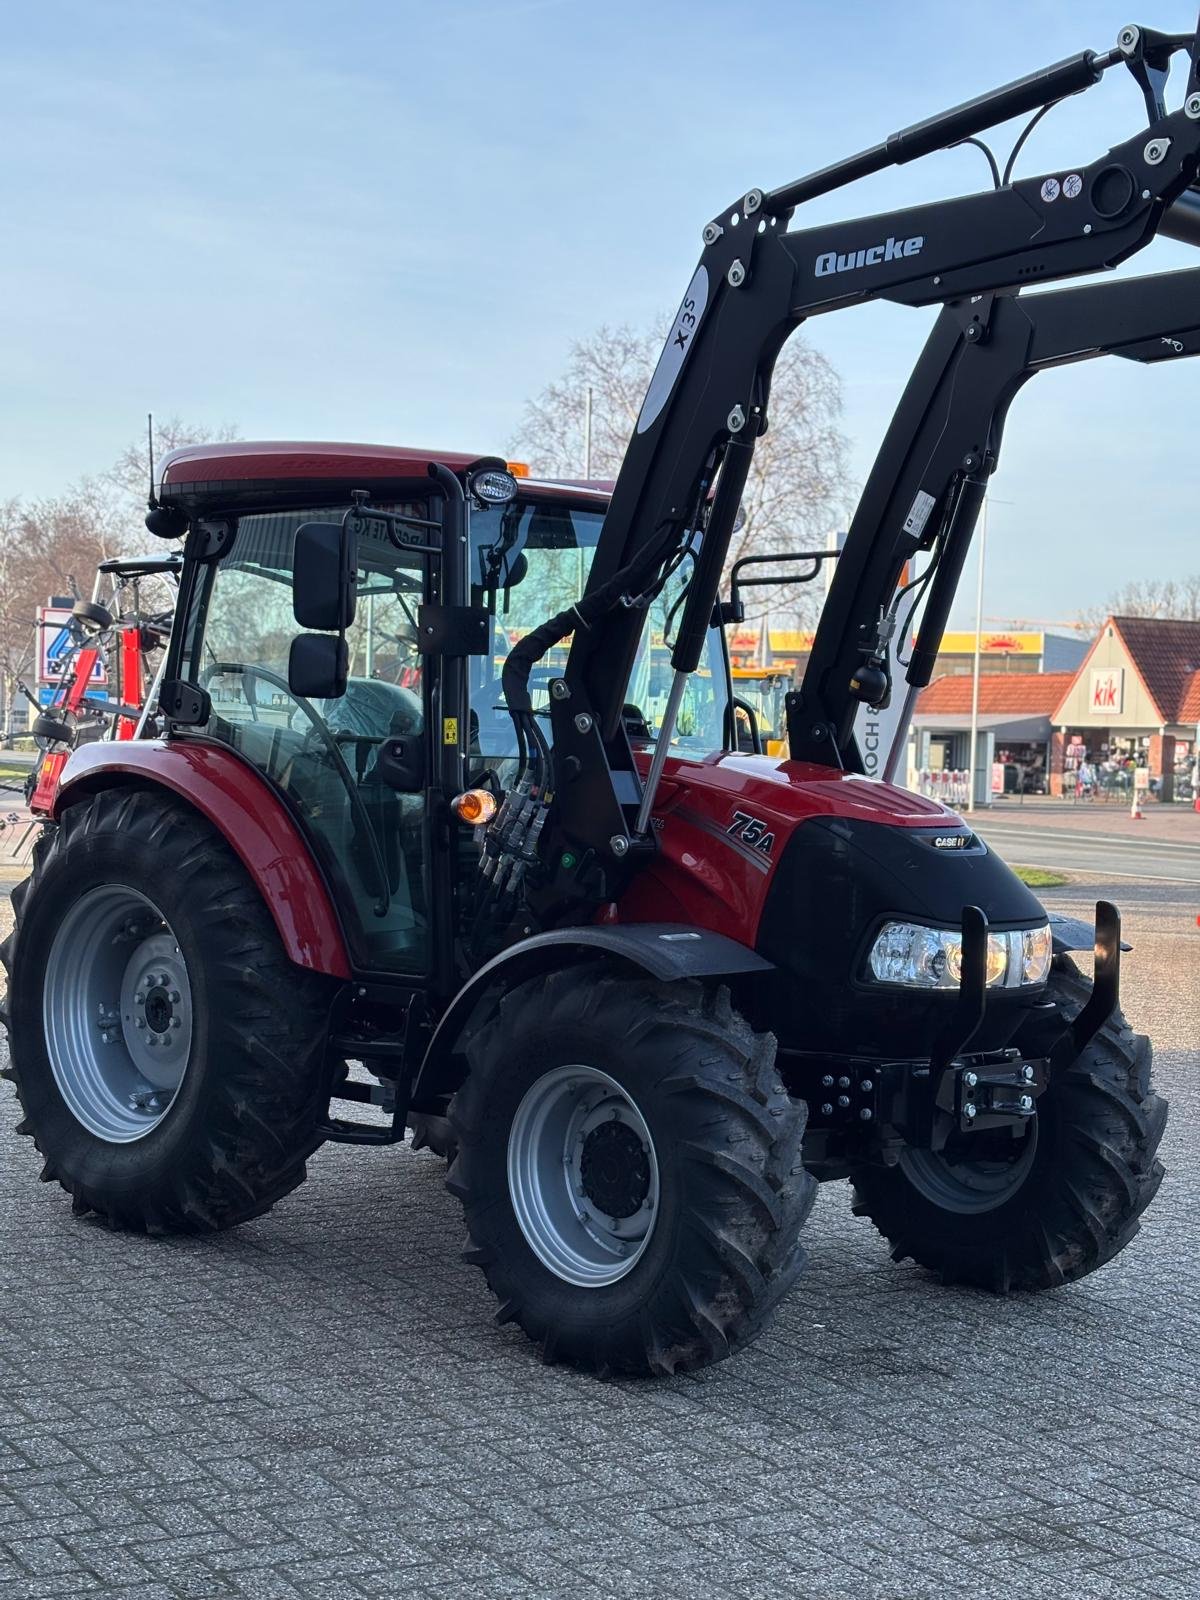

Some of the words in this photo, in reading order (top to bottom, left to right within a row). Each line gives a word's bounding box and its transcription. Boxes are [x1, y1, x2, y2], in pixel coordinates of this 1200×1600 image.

[814, 236, 924, 277] Quicke
[726, 810, 775, 854] 75A
[935, 837, 957, 847] CASE
